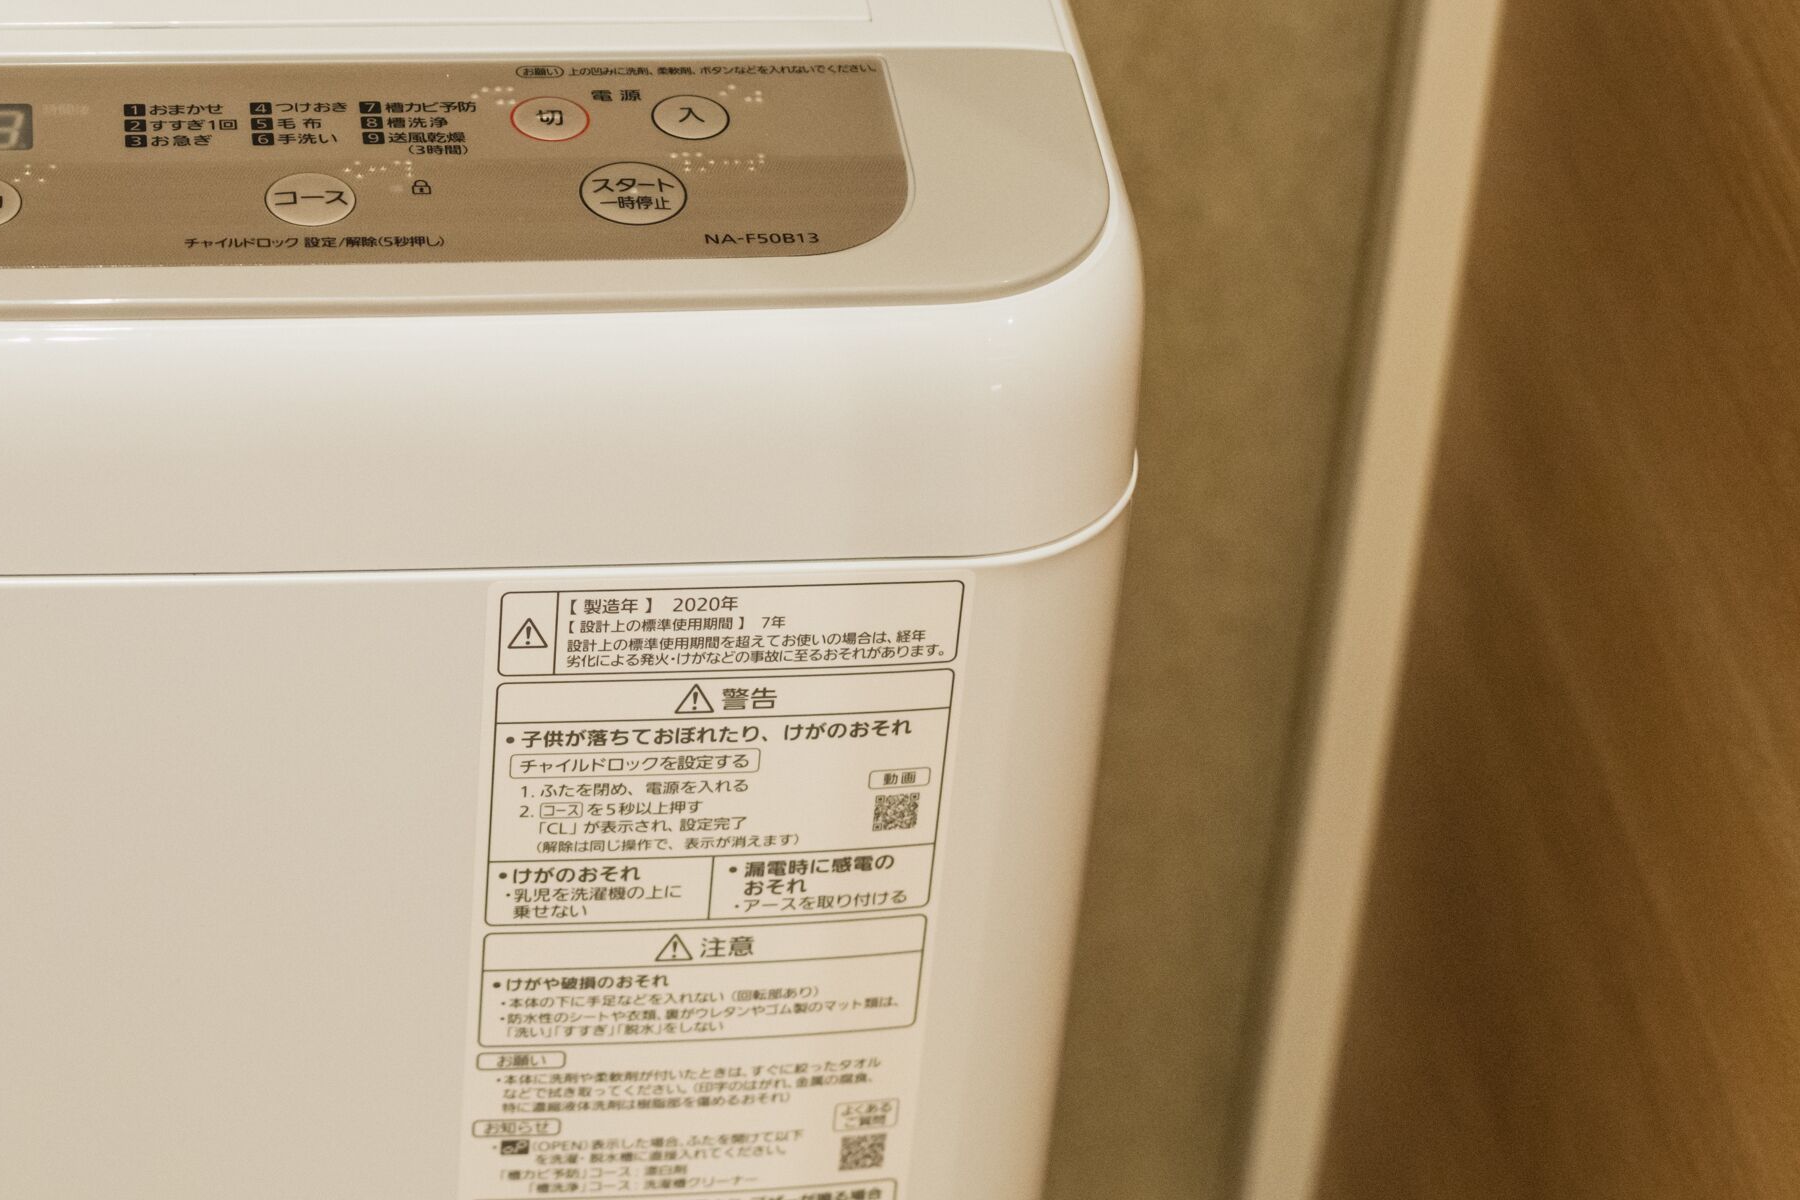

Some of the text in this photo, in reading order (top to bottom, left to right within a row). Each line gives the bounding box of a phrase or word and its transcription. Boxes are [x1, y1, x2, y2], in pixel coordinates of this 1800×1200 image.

[591, 88, 642, 102] 電源
[149, 103, 224, 116] おまかせ
[275, 101, 348, 114] つけおき
[385, 101, 477, 114] 槽カビ予防
[678, 106, 706, 123] 入
[150, 118, 238, 131] すすぎ1回
[277, 117, 322, 130] 毛布
[386, 116, 449, 129] 槽洗浄
[536, 108, 564, 126] 切
[150, 134, 213, 147] お急ぎ
[278, 132, 338, 145] 手洗い
[388, 132, 466, 145] 送風乾燥
[591, 176, 675, 193] スタート
[273, 190, 349, 206] コース
[599, 195, 672, 211] 一時停止
[184, 236, 299, 249] チャイルドロック
[703, 231, 820, 246] NA-F50B13
[672, 595, 739, 612] 2020年
[760, 615, 786, 629] 7年
[721, 686, 778, 711] 警告
[519, 754, 750, 775] チャイルドロックを設定する
[882, 771, 916, 786] 動画
[542, 804, 580, 817] コース
[586, 799, 704, 816] を5秒以上押す
[743, 854, 895, 878] 漏電時に感電の
[511, 866, 641, 885] けがのおそれ
[513, 884, 682, 903] 乳児を洗濯機の上に
[743, 878, 807, 896] おそれ
[743, 889, 908, 913] アースを取り付ける
[512, 904, 588, 920] 乗せない
[699, 936, 755, 958] 注意
[505, 974, 670, 992] けがや破損のおそれ
[841, 1102, 893, 1117] よくある
[482, 1120, 550, 1136] お知らせ
